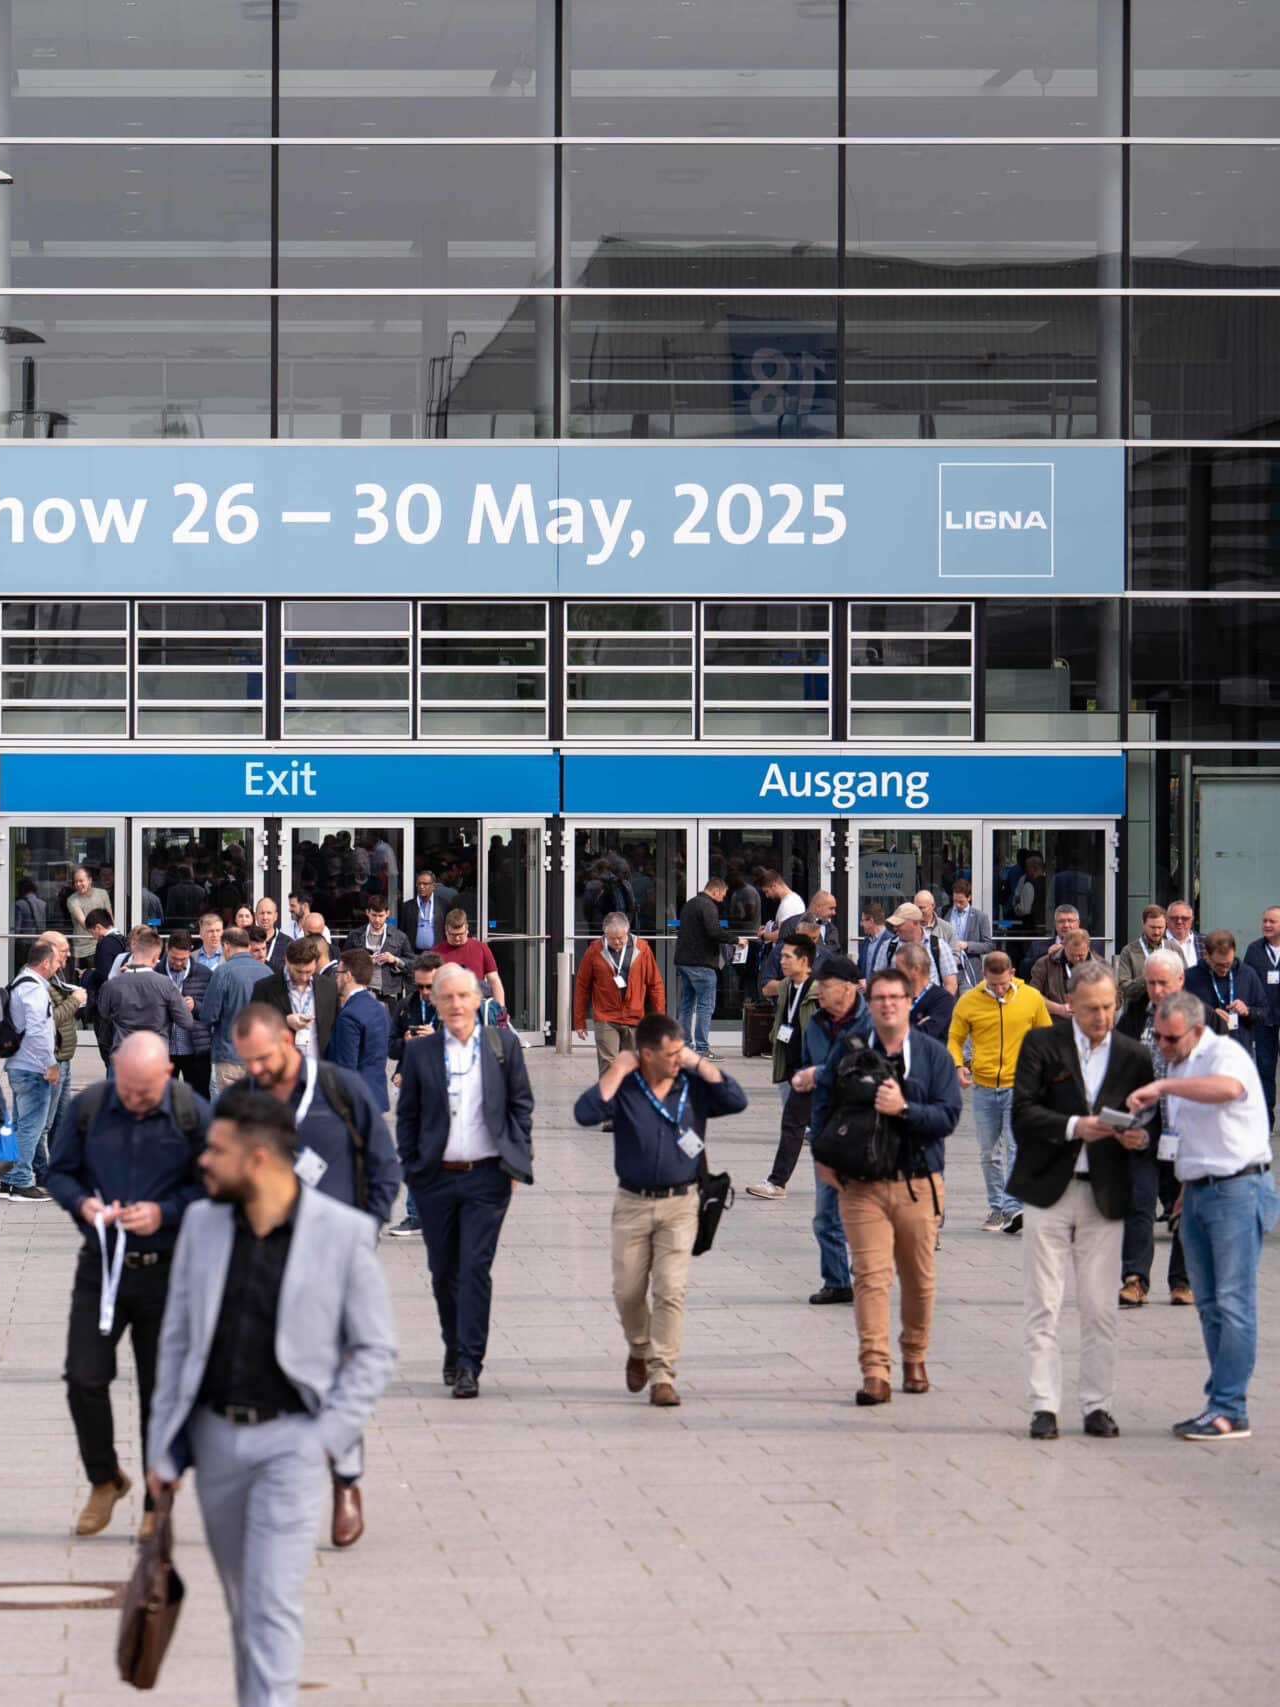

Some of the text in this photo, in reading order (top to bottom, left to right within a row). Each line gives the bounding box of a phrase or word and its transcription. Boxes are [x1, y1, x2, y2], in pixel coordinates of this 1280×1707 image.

[172, 482, 260, 545] 26
[354, 483, 442, 545] 30
[467, 483, 646, 566] May,
[673, 483, 847, 545] 2025
[945, 511, 1047, 530] LIGNA
[245, 761, 316, 795] Exit
[759, 763, 929, 809] Ausgang
